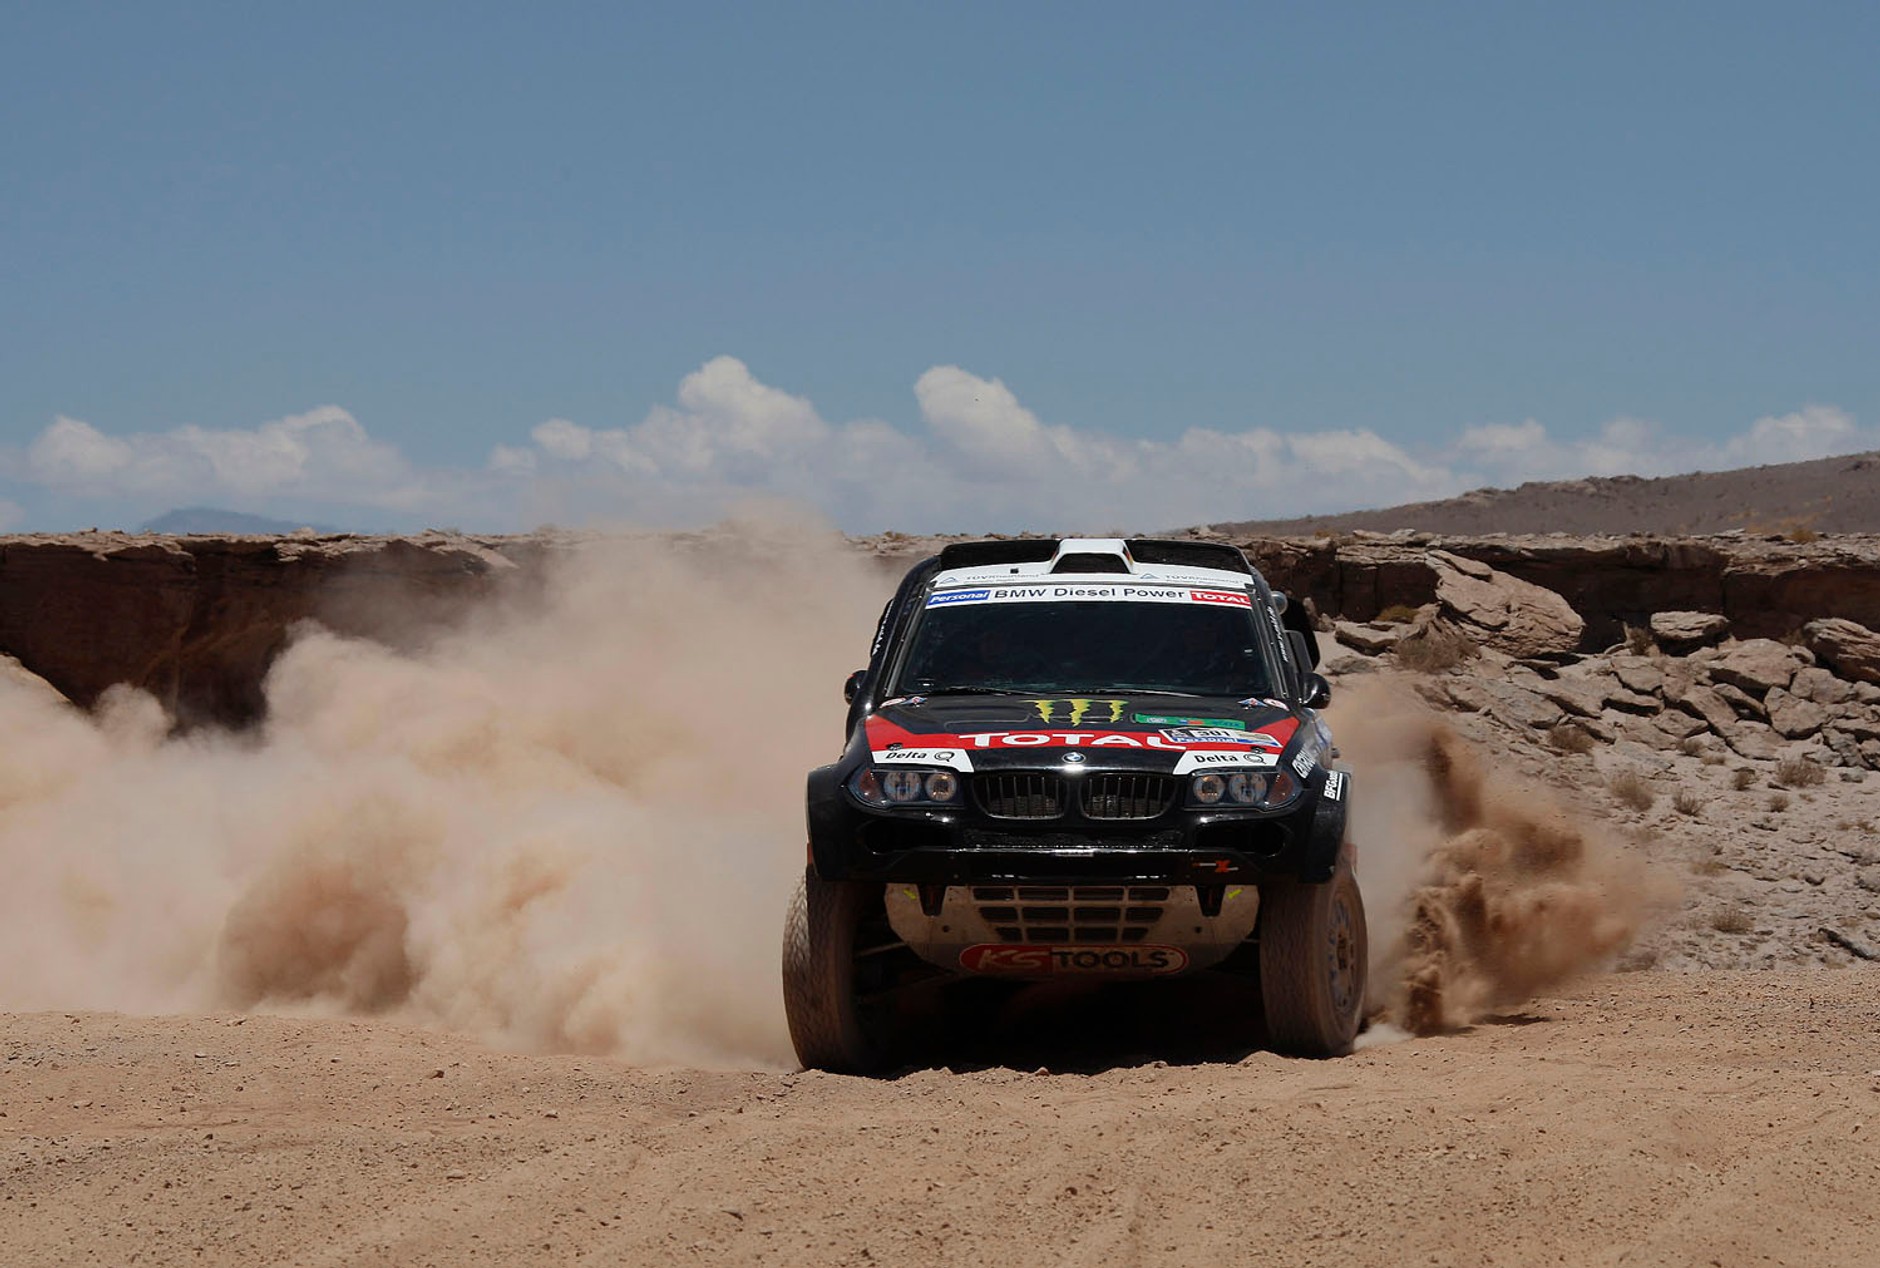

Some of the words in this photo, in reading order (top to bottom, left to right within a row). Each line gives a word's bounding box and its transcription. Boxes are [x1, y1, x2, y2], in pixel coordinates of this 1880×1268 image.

[929, 590, 989, 603] Personal
[994, 588, 1047, 599] BMW
[1054, 587, 1116, 598] Diesel
[1123, 587, 1185, 599] Power
[1192, 592, 1250, 605] TOTAL
[958, 732, 1187, 751] TOTAL
[885, 751, 927, 760] Delta
[1194, 753, 1239, 764] Delta
